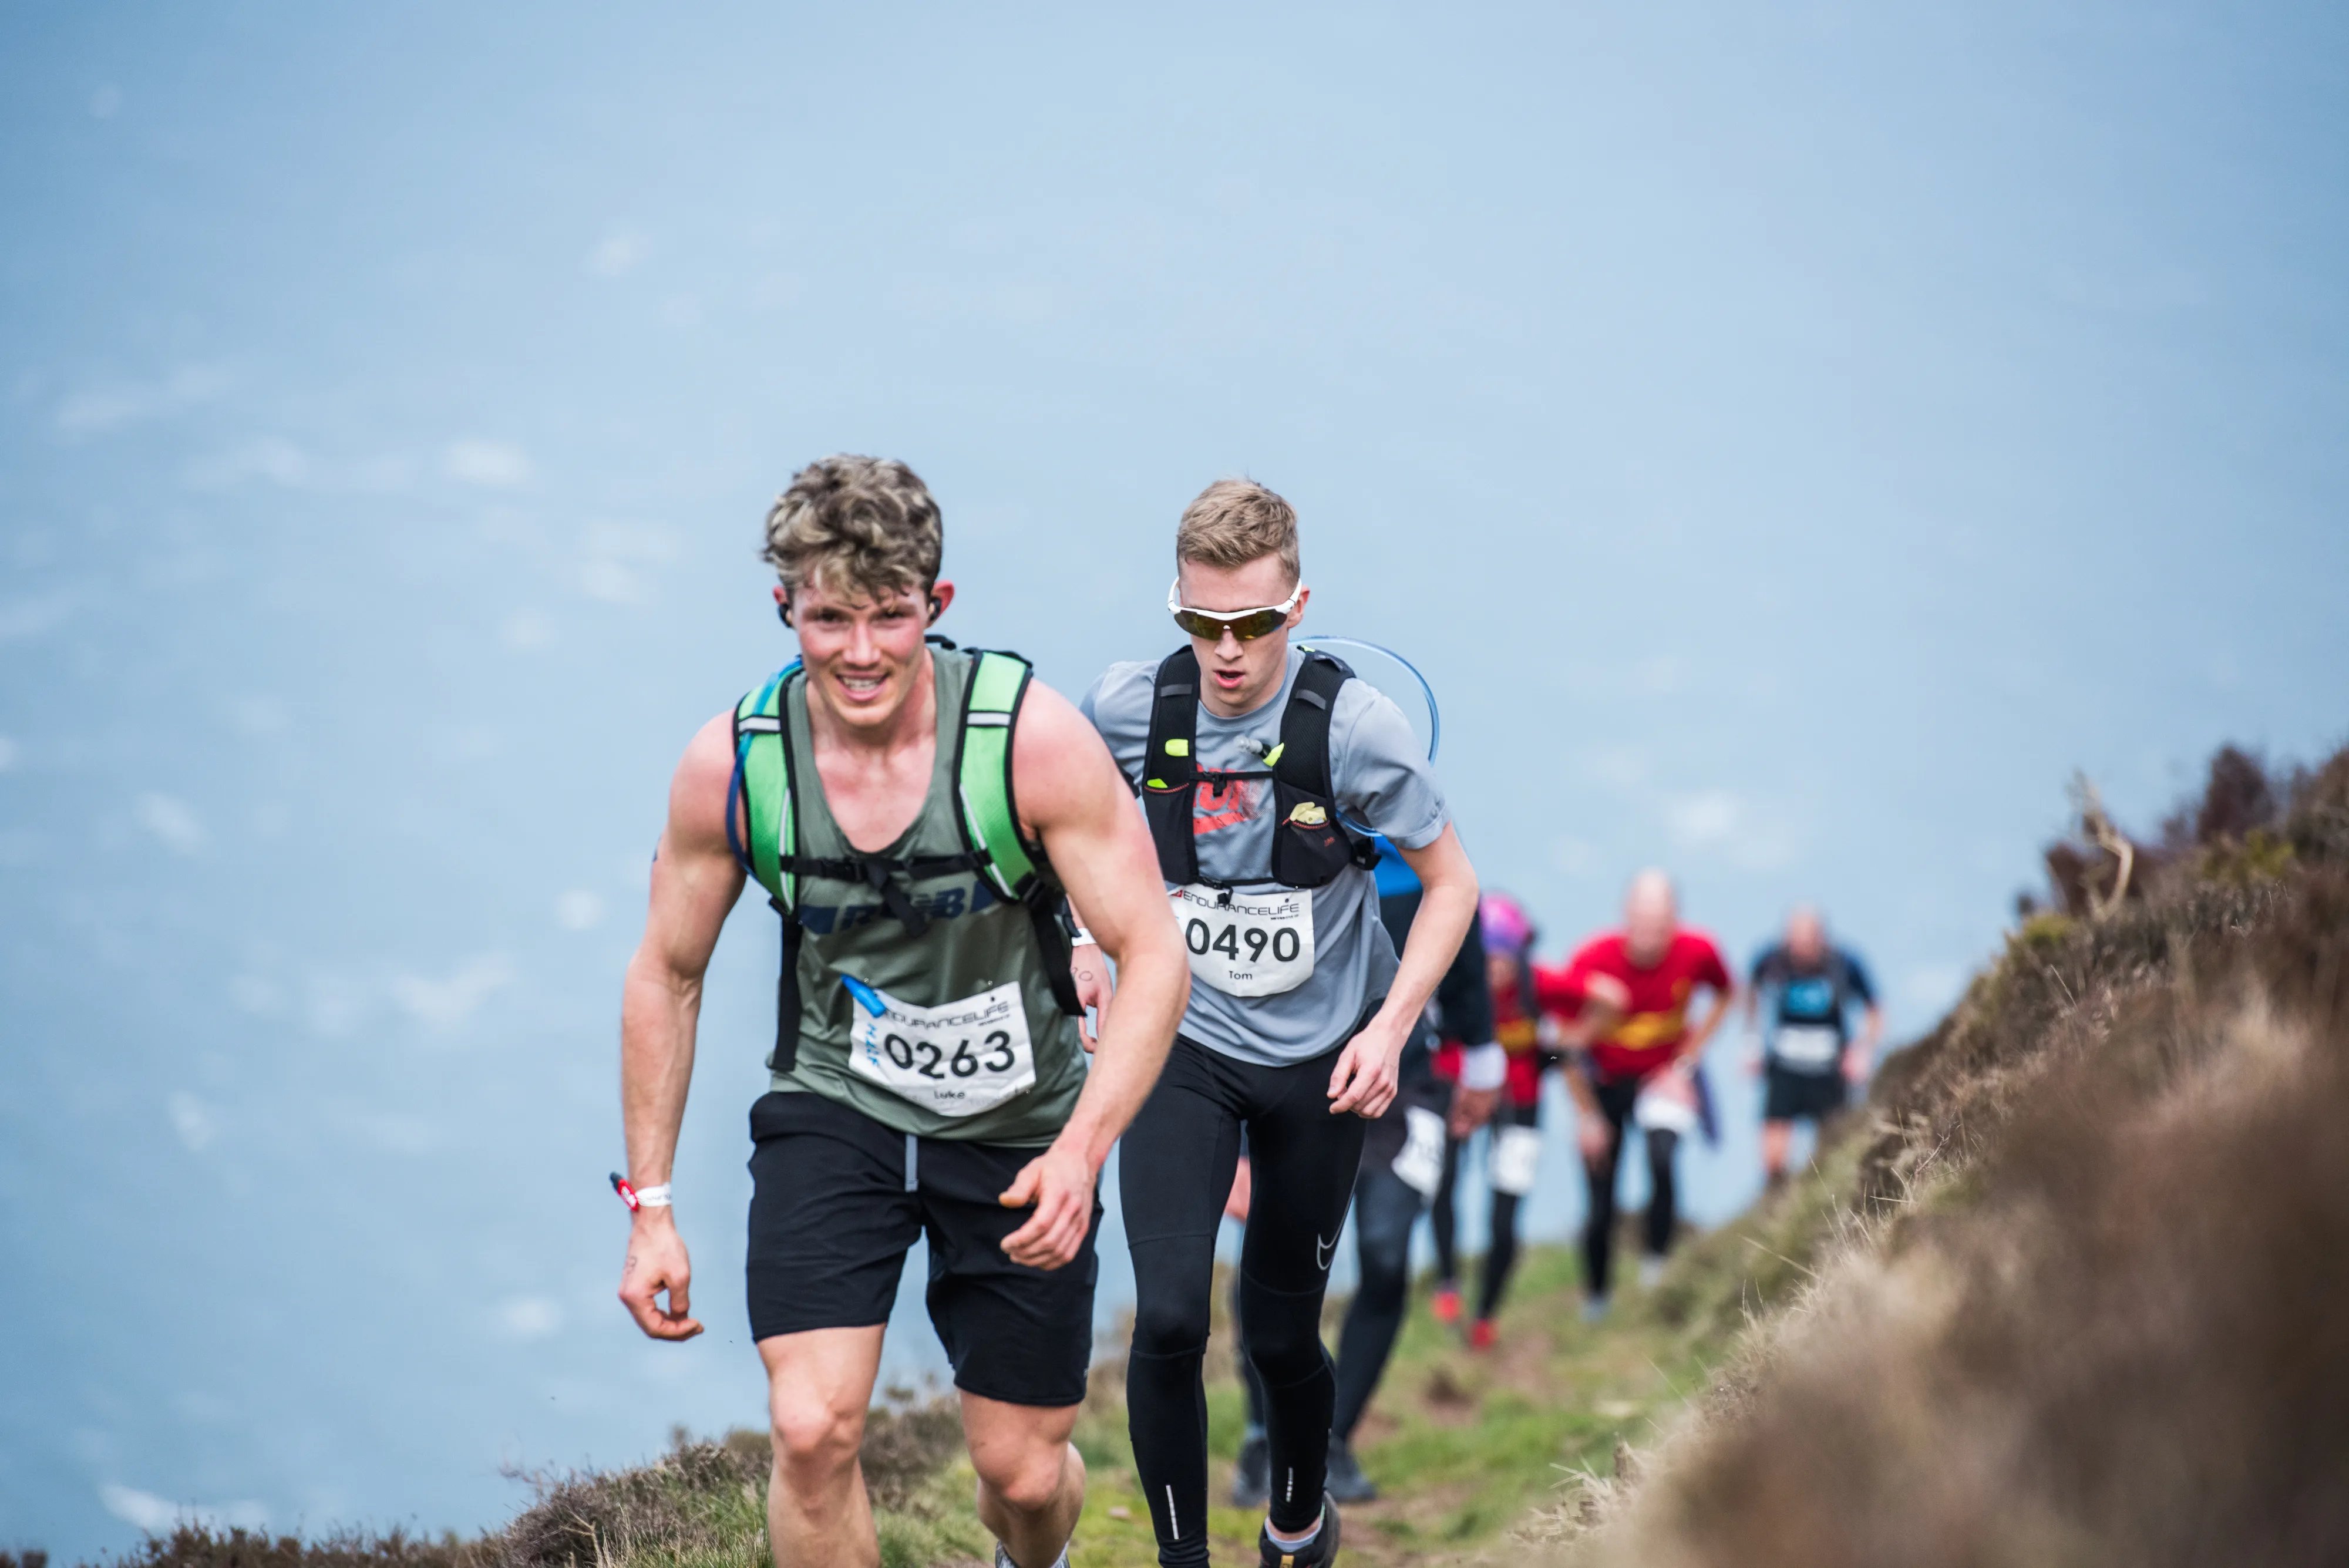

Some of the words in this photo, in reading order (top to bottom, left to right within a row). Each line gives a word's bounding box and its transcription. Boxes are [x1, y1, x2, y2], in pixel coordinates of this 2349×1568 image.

[1185, 918, 1300, 963] 0490
[1229, 970, 1253, 980] Tom
[884, 1030, 1015, 1079] 0263
[934, 1090, 965, 1100] Luke
